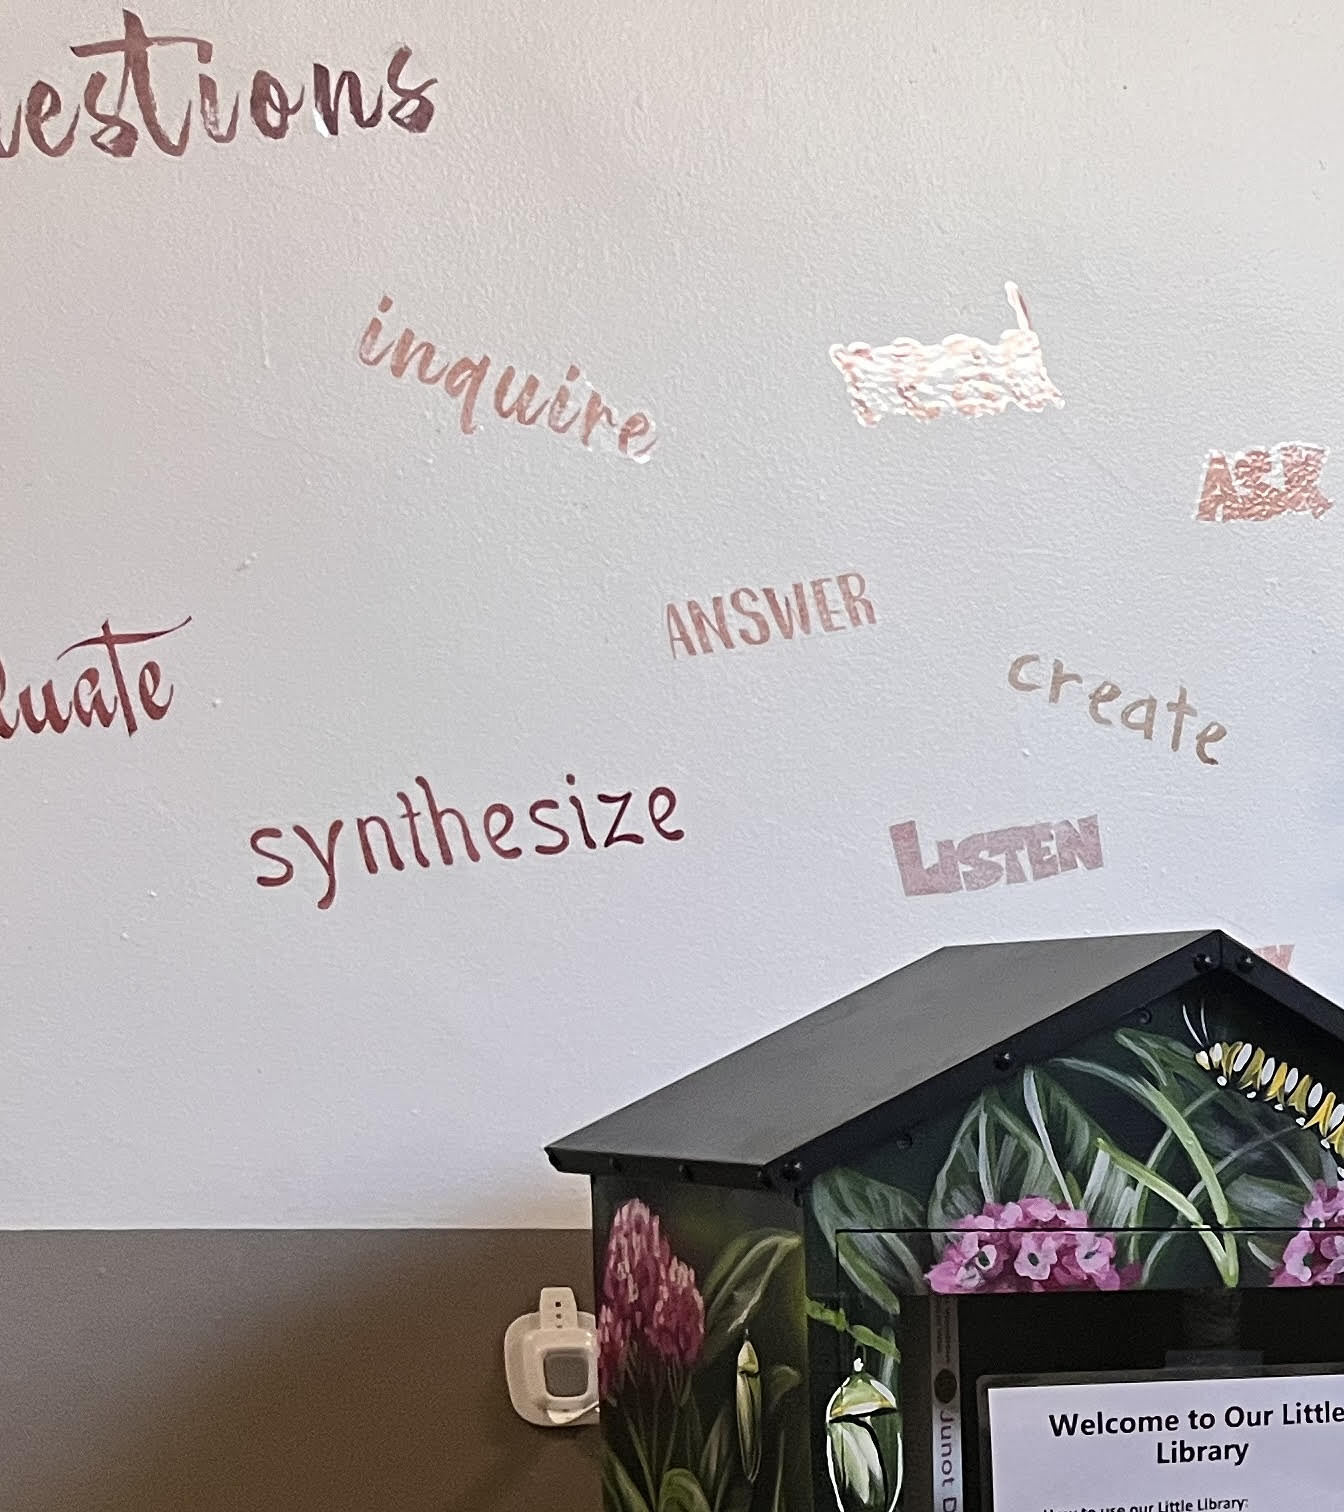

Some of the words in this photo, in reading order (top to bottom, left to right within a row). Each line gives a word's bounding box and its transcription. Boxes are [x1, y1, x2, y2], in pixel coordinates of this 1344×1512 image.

[0, 8, 439, 158] estions
[357, 293, 659, 465] inquire
[1192, 441, 1335, 522] ASK
[664, 571, 878, 661] ANSWER
[1006, 653, 1228, 767] create
[249, 774, 687, 911] synthesize
[939, 1409, 957, 1488] Junot
[1048, 1410, 1180, 1438] Welcome
[1186, 1408, 1216, 1430] to
[1224, 1404, 1274, 1428] Our
[1156, 1438, 1250, 1466] Library
